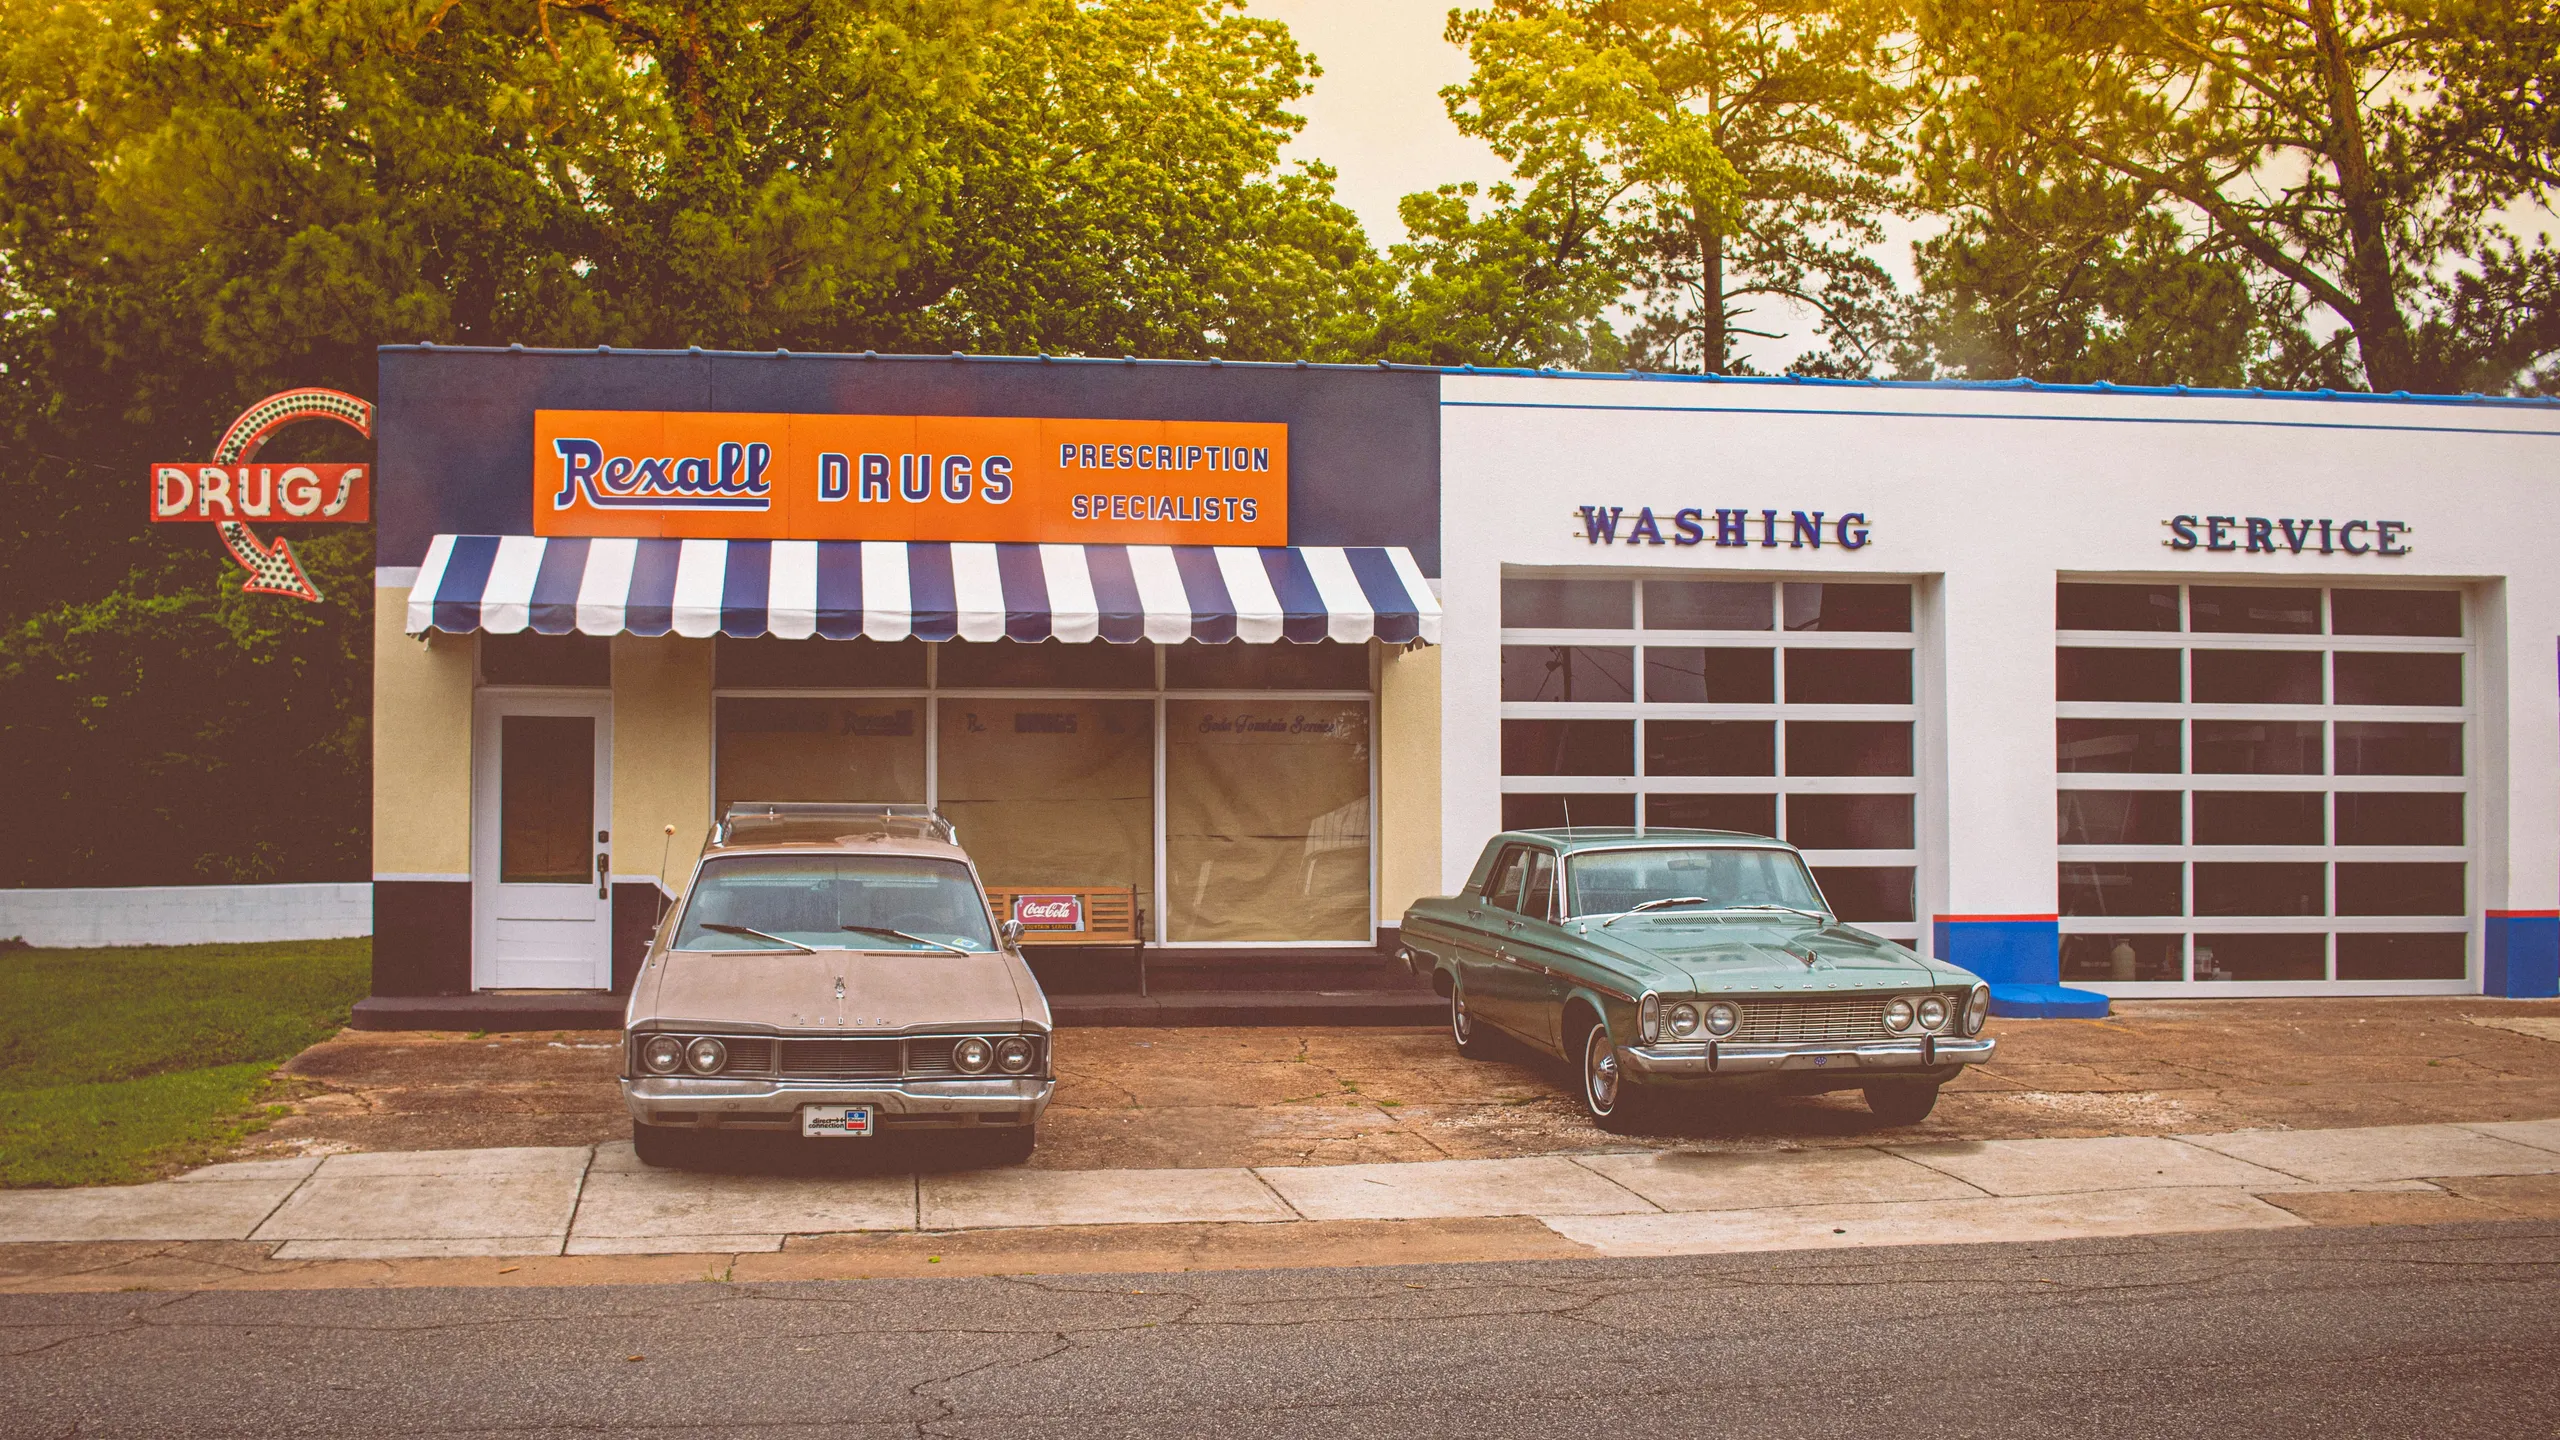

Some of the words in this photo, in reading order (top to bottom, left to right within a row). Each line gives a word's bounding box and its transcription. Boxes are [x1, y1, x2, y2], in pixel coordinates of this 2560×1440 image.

[553, 438, 771, 511] Rexall
[818, 452, 1013, 504] DRUGS
[1060, 443, 1270, 472] PRESCRIPTION
[158, 467, 363, 517] DRUGS
[1072, 494, 1258, 523] SPECIALISTS
[1579, 505, 1869, 550] WASHING
[2171, 514, 2406, 556] SERVICE
